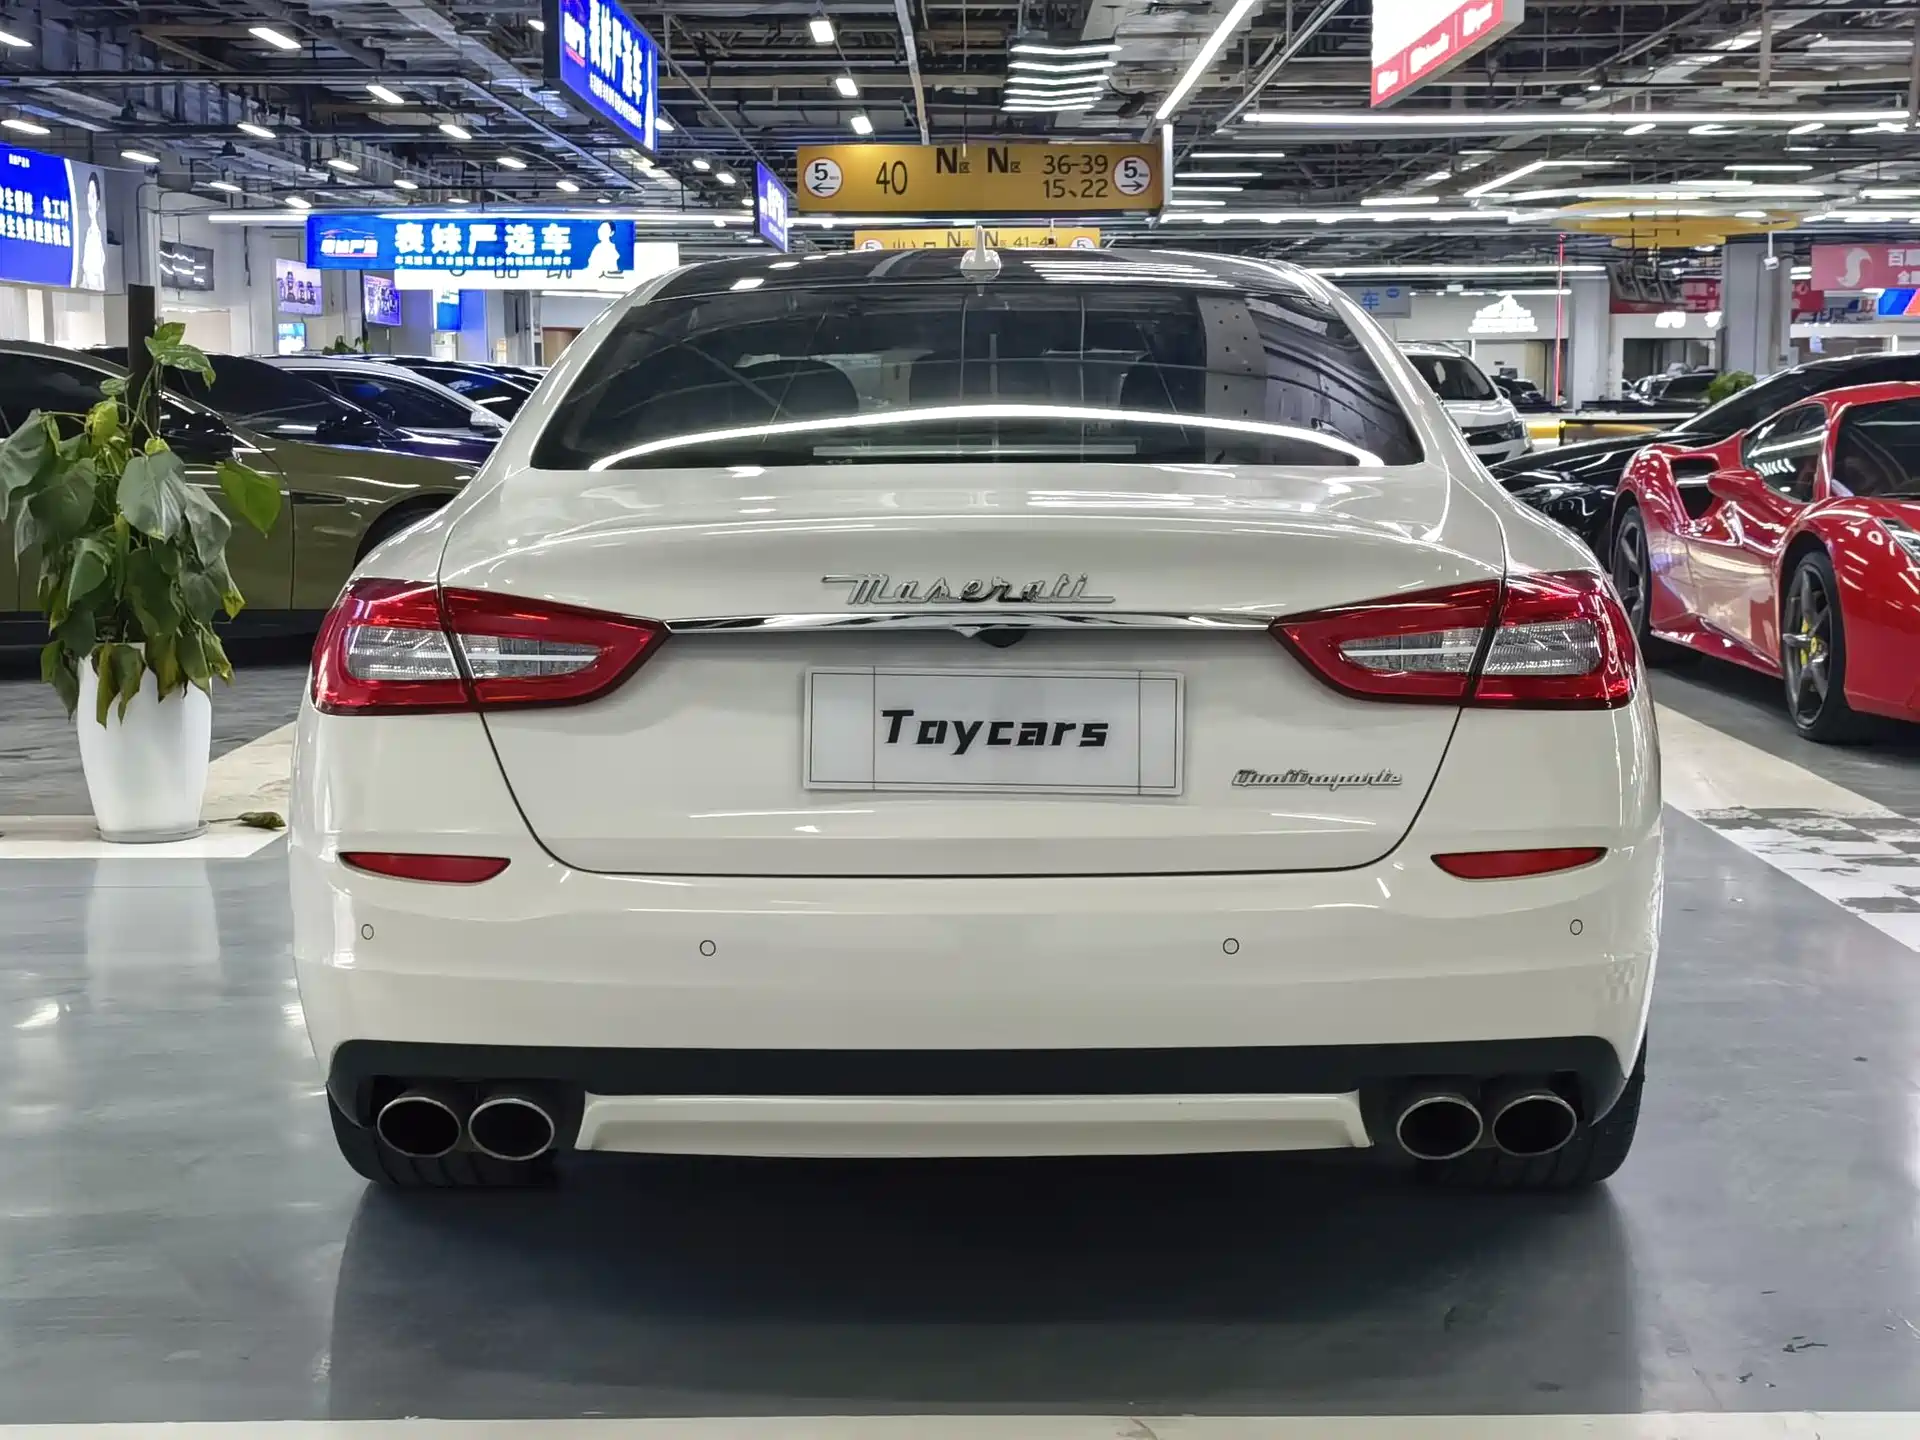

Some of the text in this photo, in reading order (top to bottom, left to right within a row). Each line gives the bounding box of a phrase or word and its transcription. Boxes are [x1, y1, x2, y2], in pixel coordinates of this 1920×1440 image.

[814, 162, 829, 181] 5
[876, 160, 908, 195] 40
[1042, 154, 1109, 175] 36-39
[1123, 160, 1138, 179] 5
[821, 572, 1116, 605] Maserati
[880, 709, 1109, 755] Toycars
